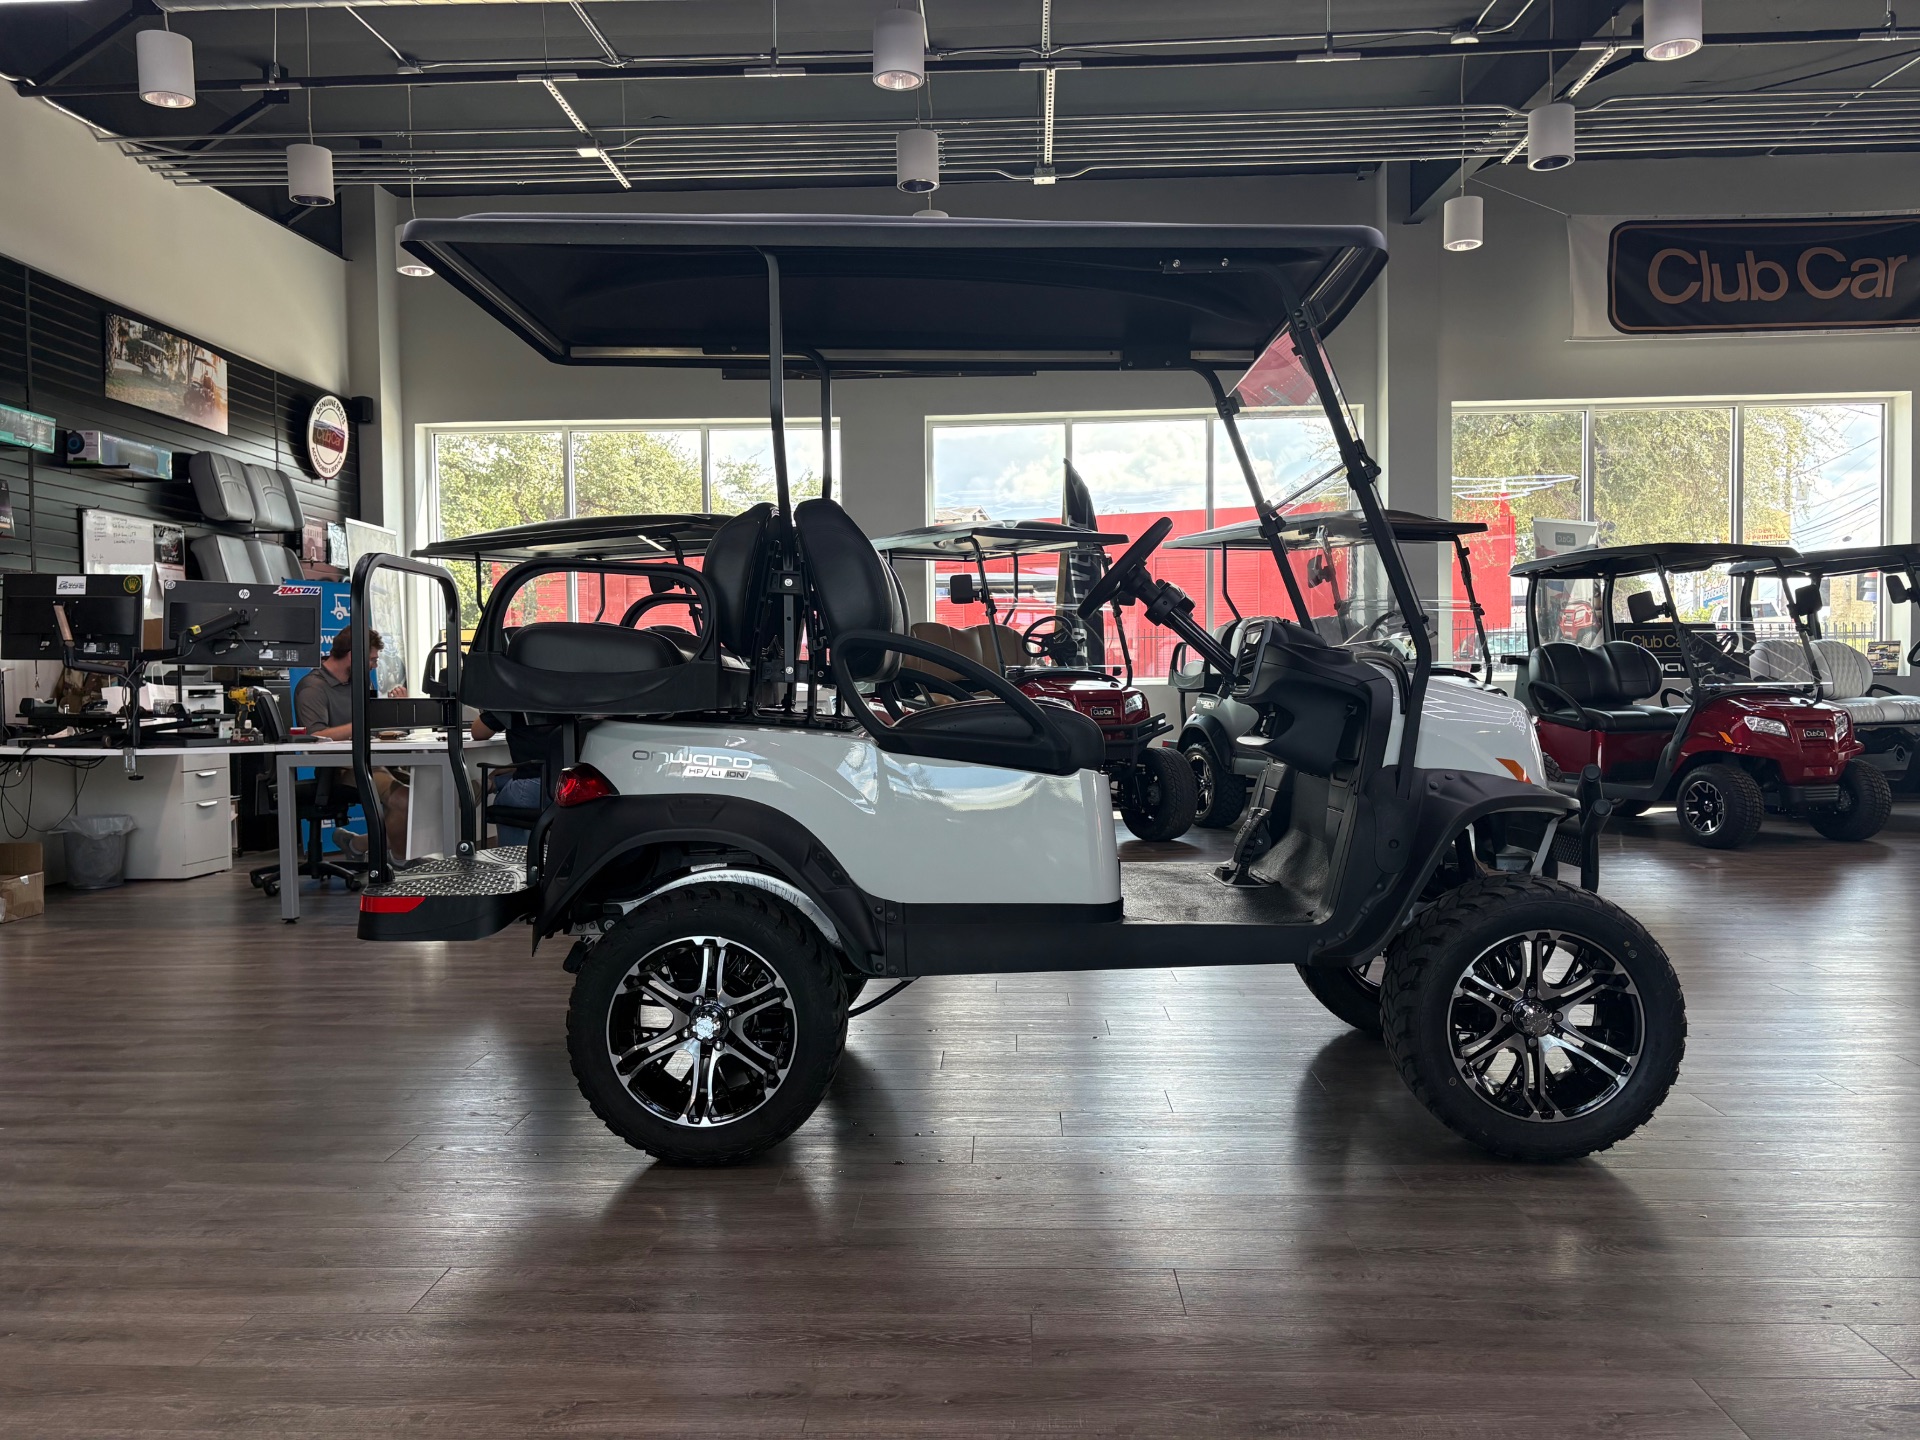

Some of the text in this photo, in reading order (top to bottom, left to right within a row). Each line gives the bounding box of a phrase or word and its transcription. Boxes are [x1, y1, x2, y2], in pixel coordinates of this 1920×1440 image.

[1647, 246, 1908, 305] Club Car
[316, 399, 346, 426] GENUINE PARTS
[240, 588, 249, 599] hp
[276, 586, 321, 596] AMSOIL
[1631, 635, 1681, 649] Club Ca
